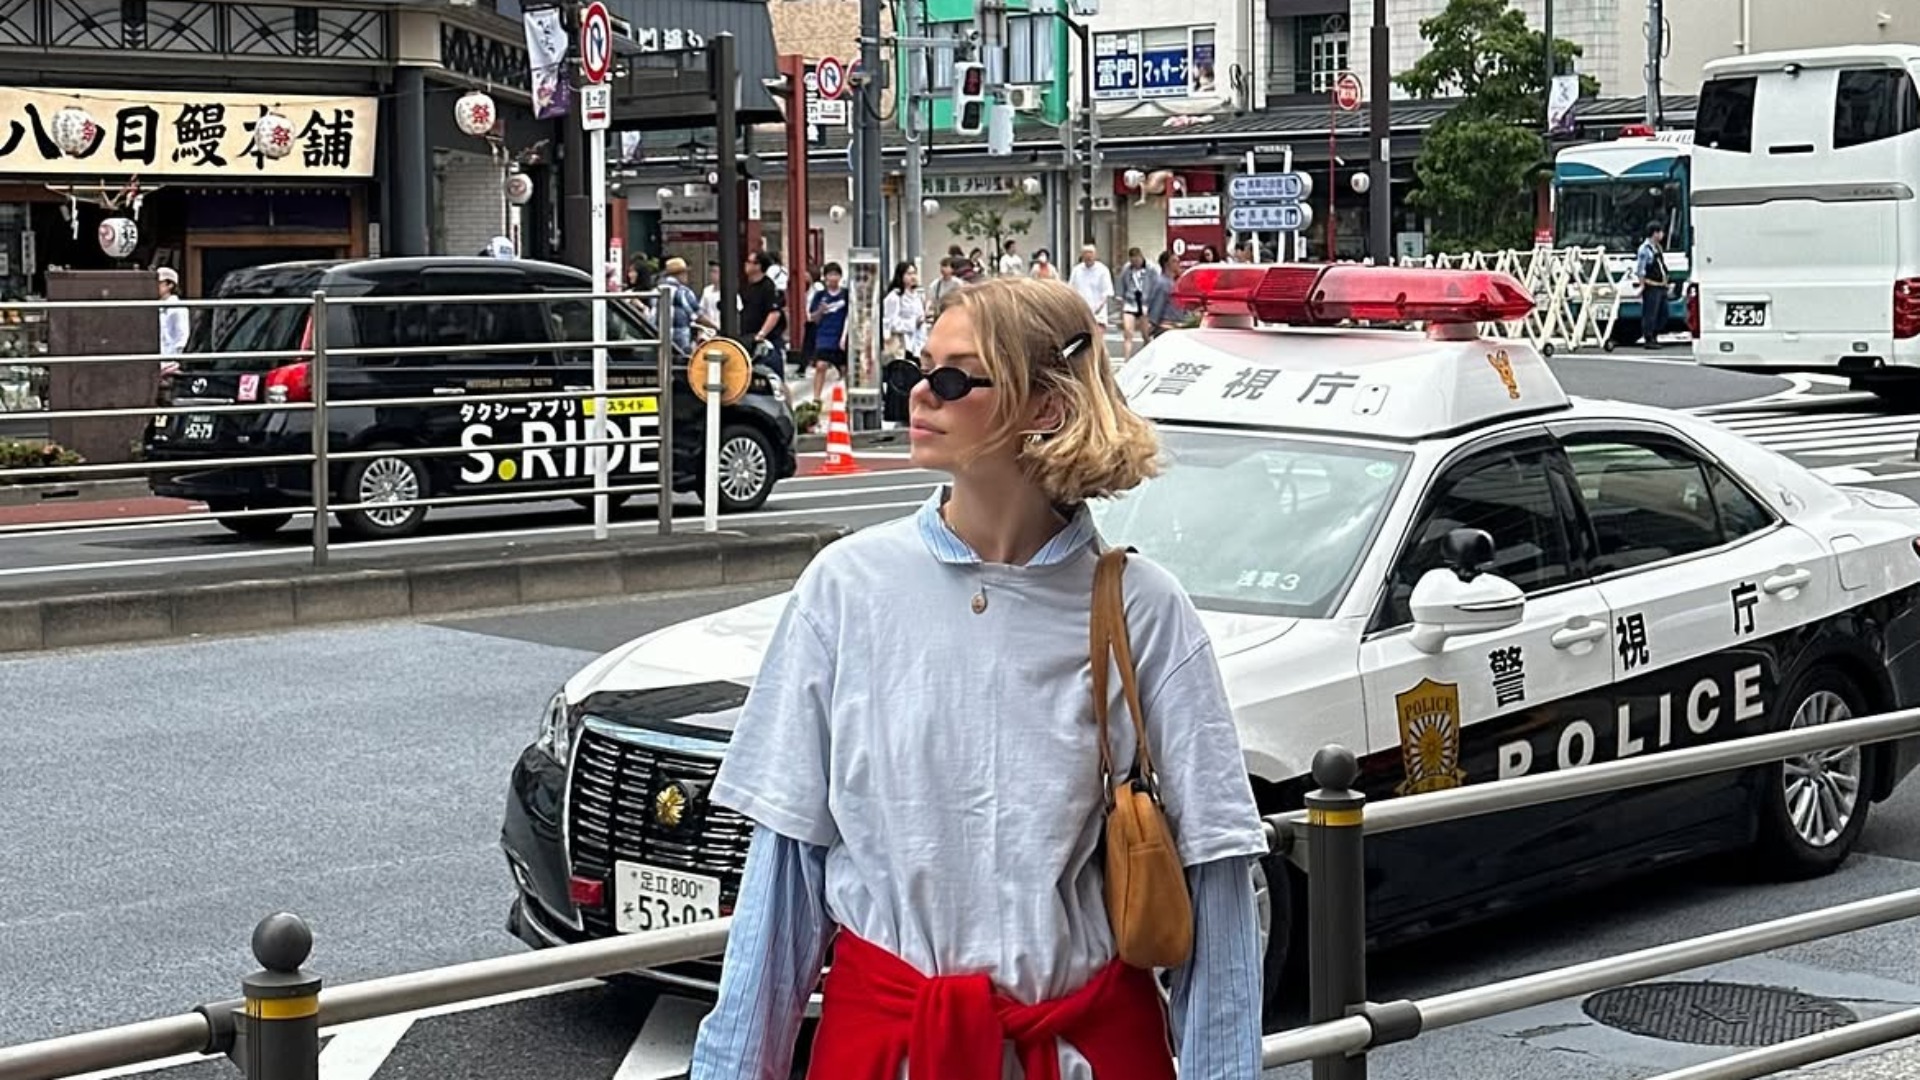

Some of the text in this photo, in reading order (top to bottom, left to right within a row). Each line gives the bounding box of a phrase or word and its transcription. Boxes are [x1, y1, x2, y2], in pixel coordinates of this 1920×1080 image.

[1097, 58, 1137, 87] 雷門
[0, 103, 356, 170] 八目鰻本舗
[1151, 361, 1361, 406] 警視庁
[460, 399, 647, 423] タクシーアプリ スライド
[1405, 697, 1453, 720] POLICE
[1497, 663, 1764, 782] POLICE
